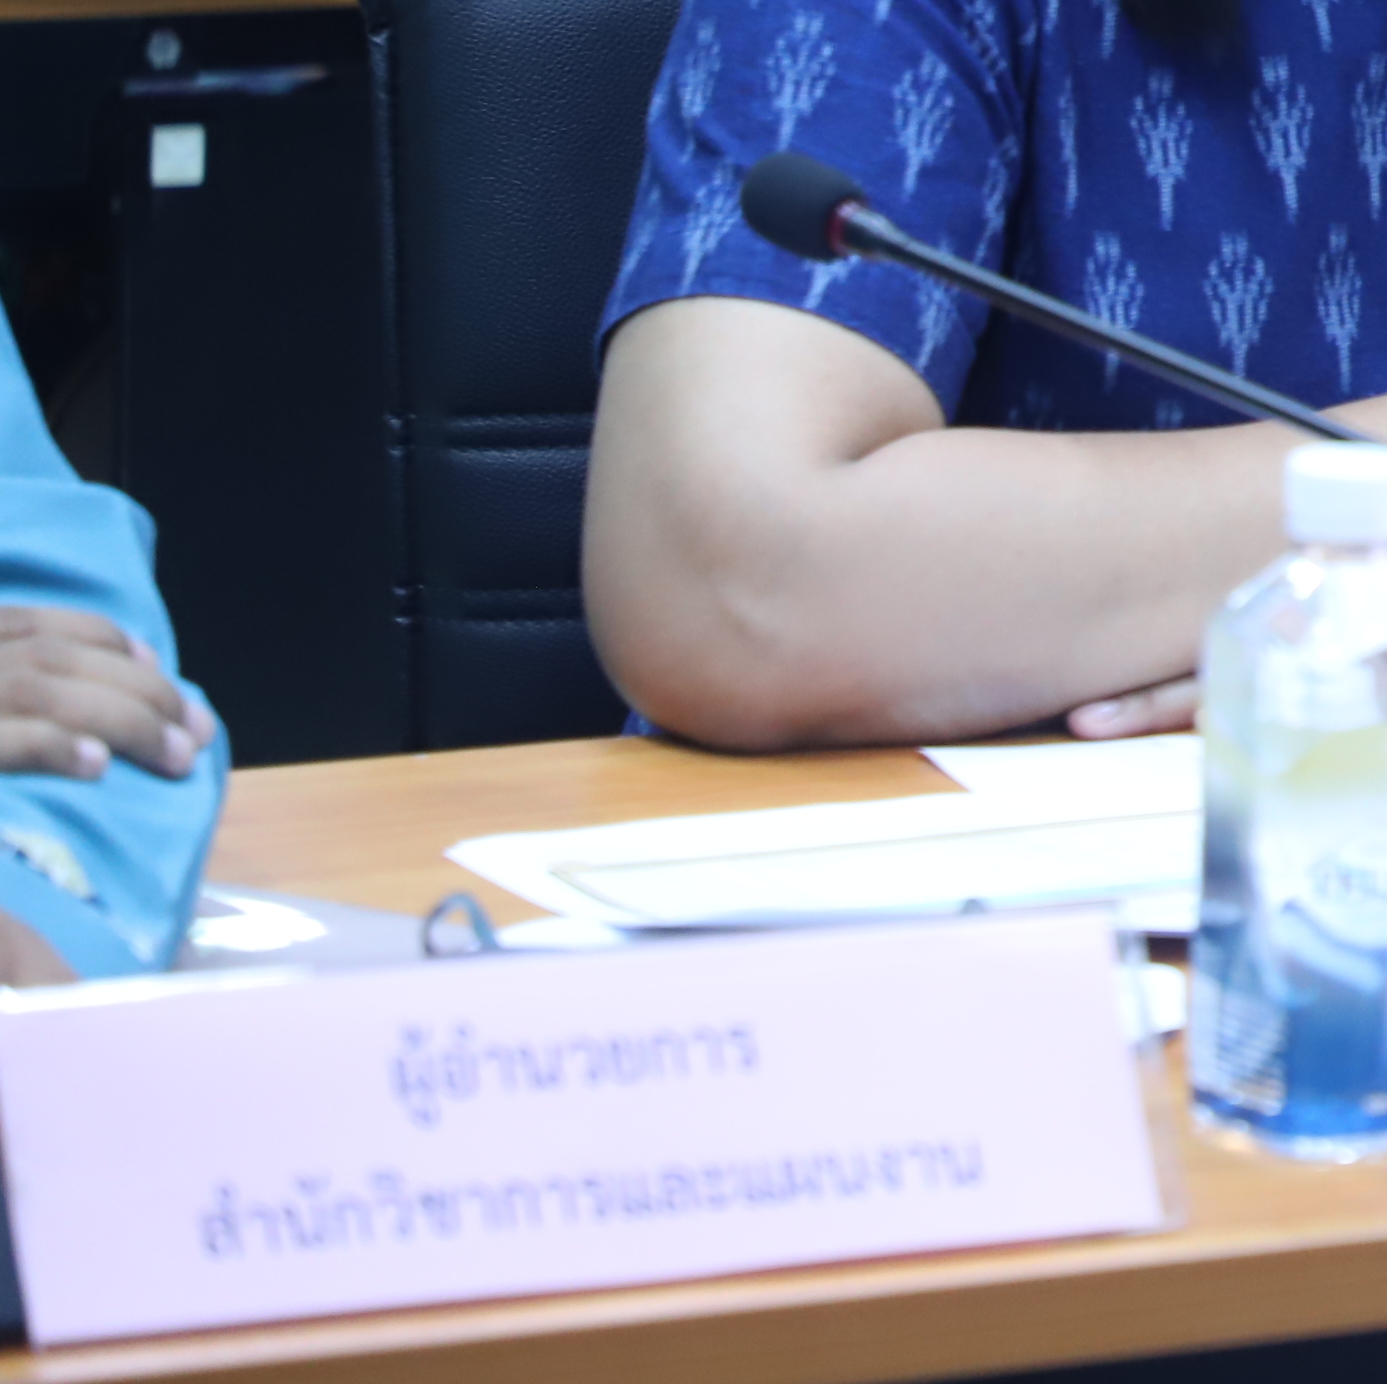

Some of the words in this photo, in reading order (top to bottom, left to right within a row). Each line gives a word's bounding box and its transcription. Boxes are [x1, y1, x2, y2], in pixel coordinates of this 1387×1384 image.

[387, 1023, 760, 1131] ผู้อำนวยการ
[201, 1140, 984, 1260] สำนักวิชาการและแผนงาน
